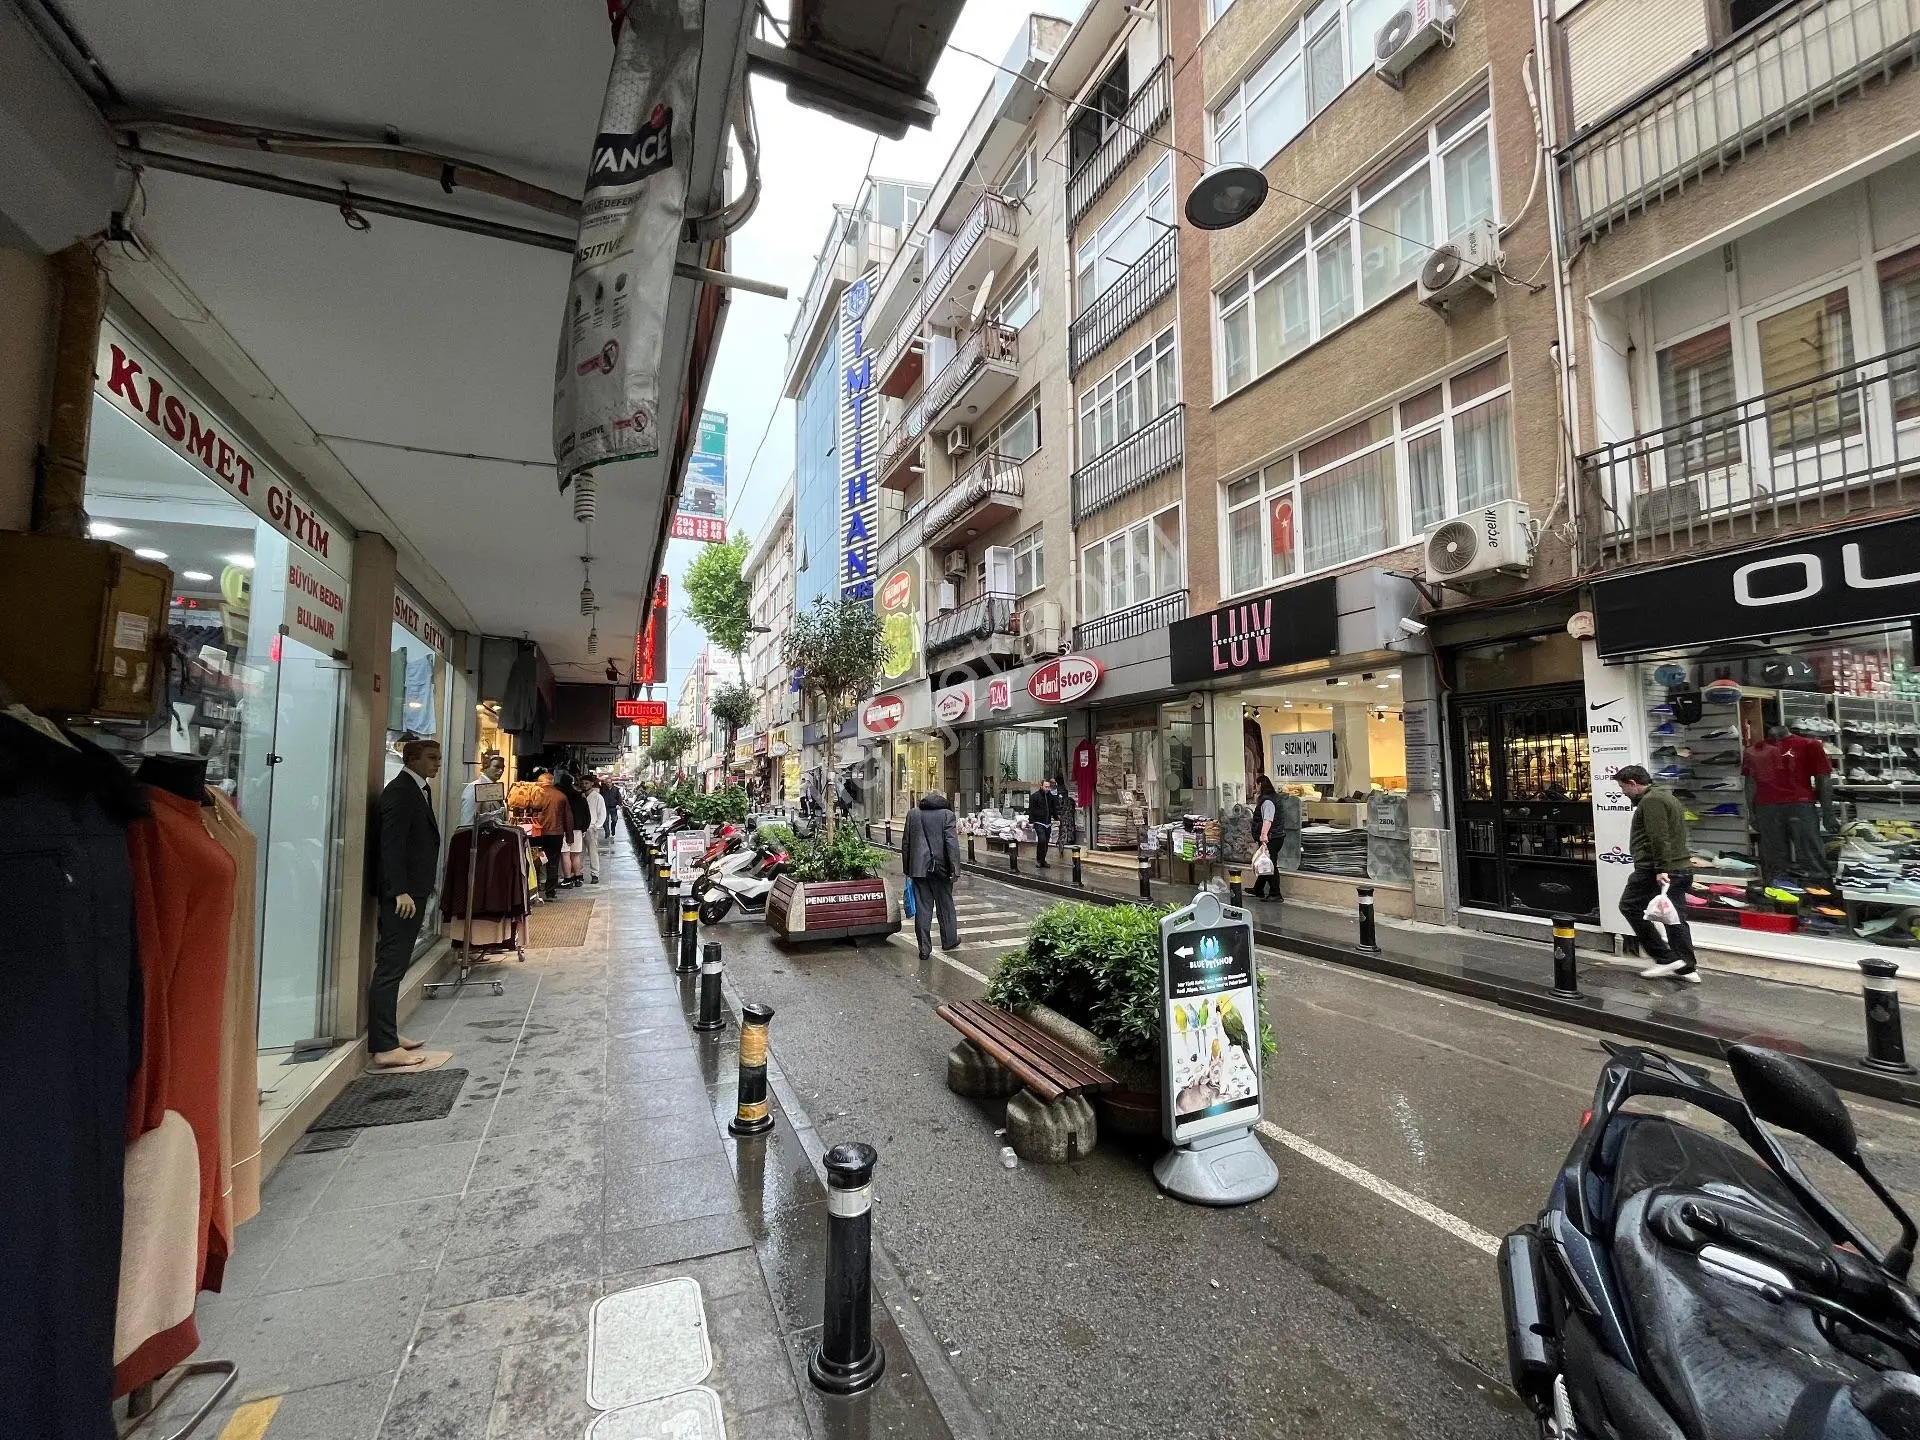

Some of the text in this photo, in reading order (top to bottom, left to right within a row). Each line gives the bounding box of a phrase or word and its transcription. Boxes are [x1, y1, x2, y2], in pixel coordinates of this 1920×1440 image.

[107, 343, 329, 559] KISMET GİYİM
[698, 519, 708, 530] 13
[1484, 509, 1499, 548] arçelik
[289, 565, 344, 614] BÜYÜK BEDEN
[296, 606, 334, 641] BULUNUR
[1211, 598, 1272, 671] LUV
[1060, 670, 1093, 688] store
[1590, 725, 1619, 733] PUMA
[1284, 738, 1317, 757] SİZİN İÇİN
[1276, 761, 1328, 777] YENİLENİYORUZ
[1596, 803, 1634, 812] hummel
